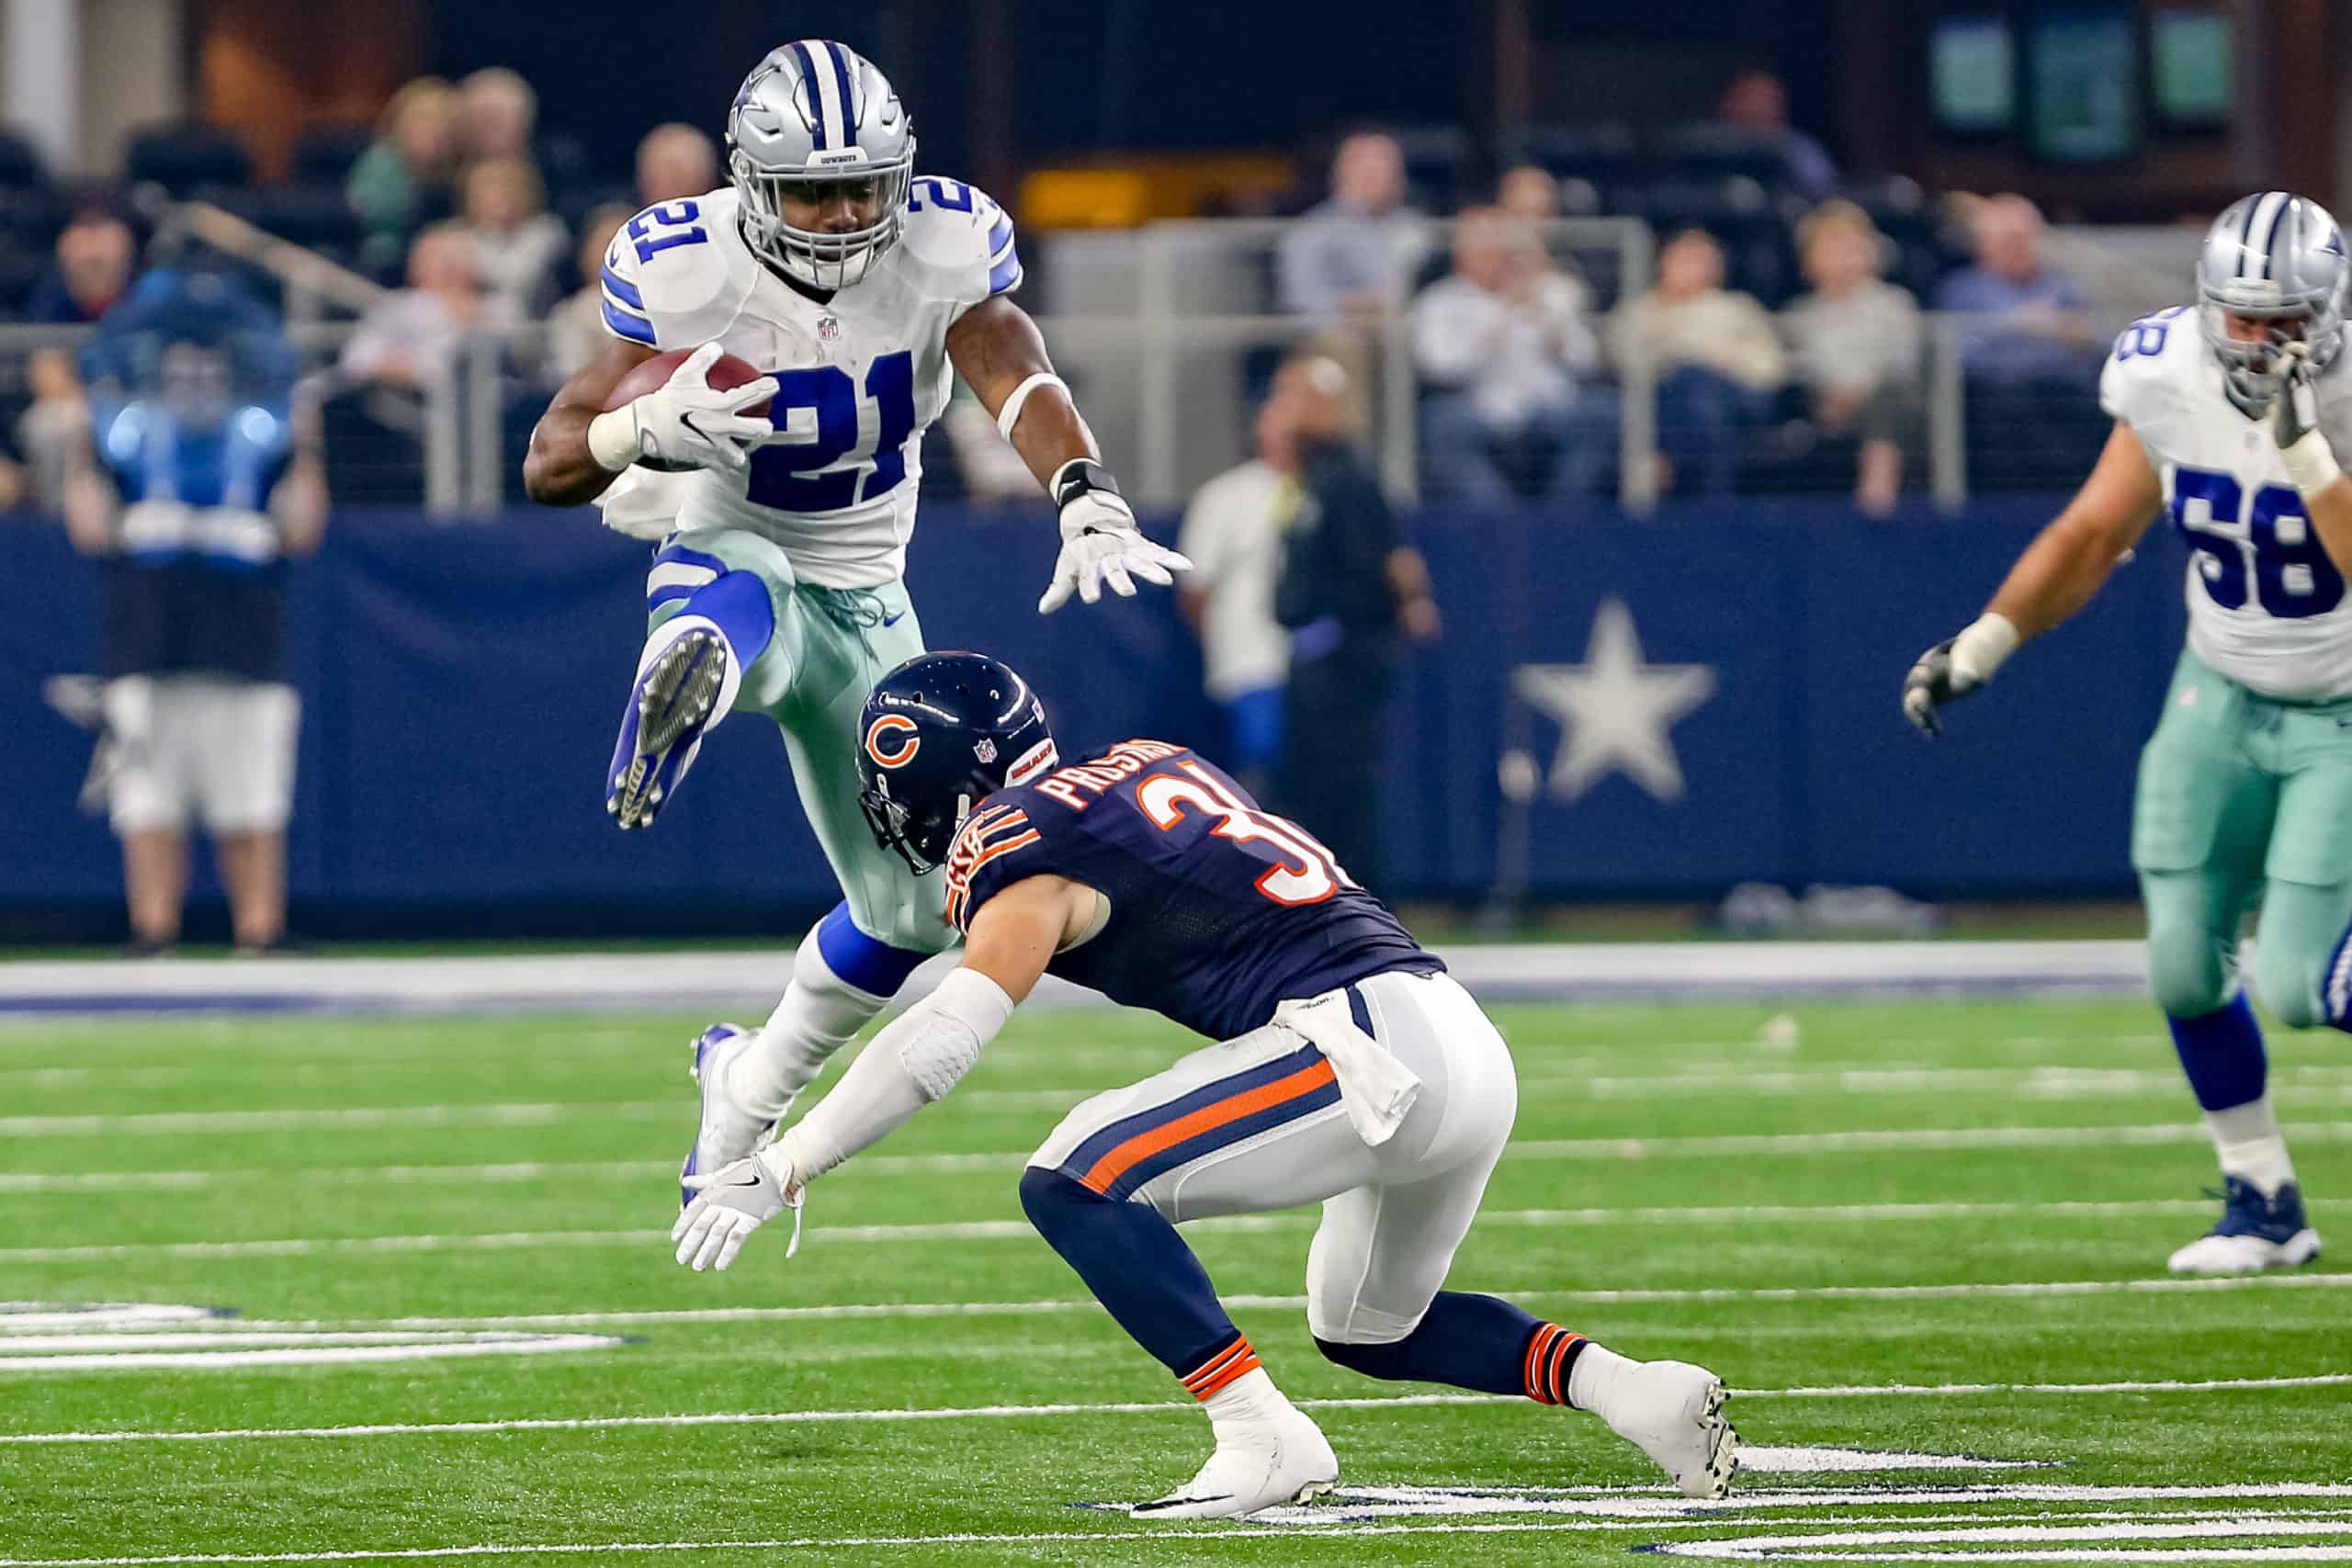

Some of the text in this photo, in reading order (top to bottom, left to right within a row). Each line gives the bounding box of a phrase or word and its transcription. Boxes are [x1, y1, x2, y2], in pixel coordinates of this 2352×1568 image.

[628, 200, 708, 265] 21
[745, 349, 917, 513] 21
[865, 714, 921, 769] C
